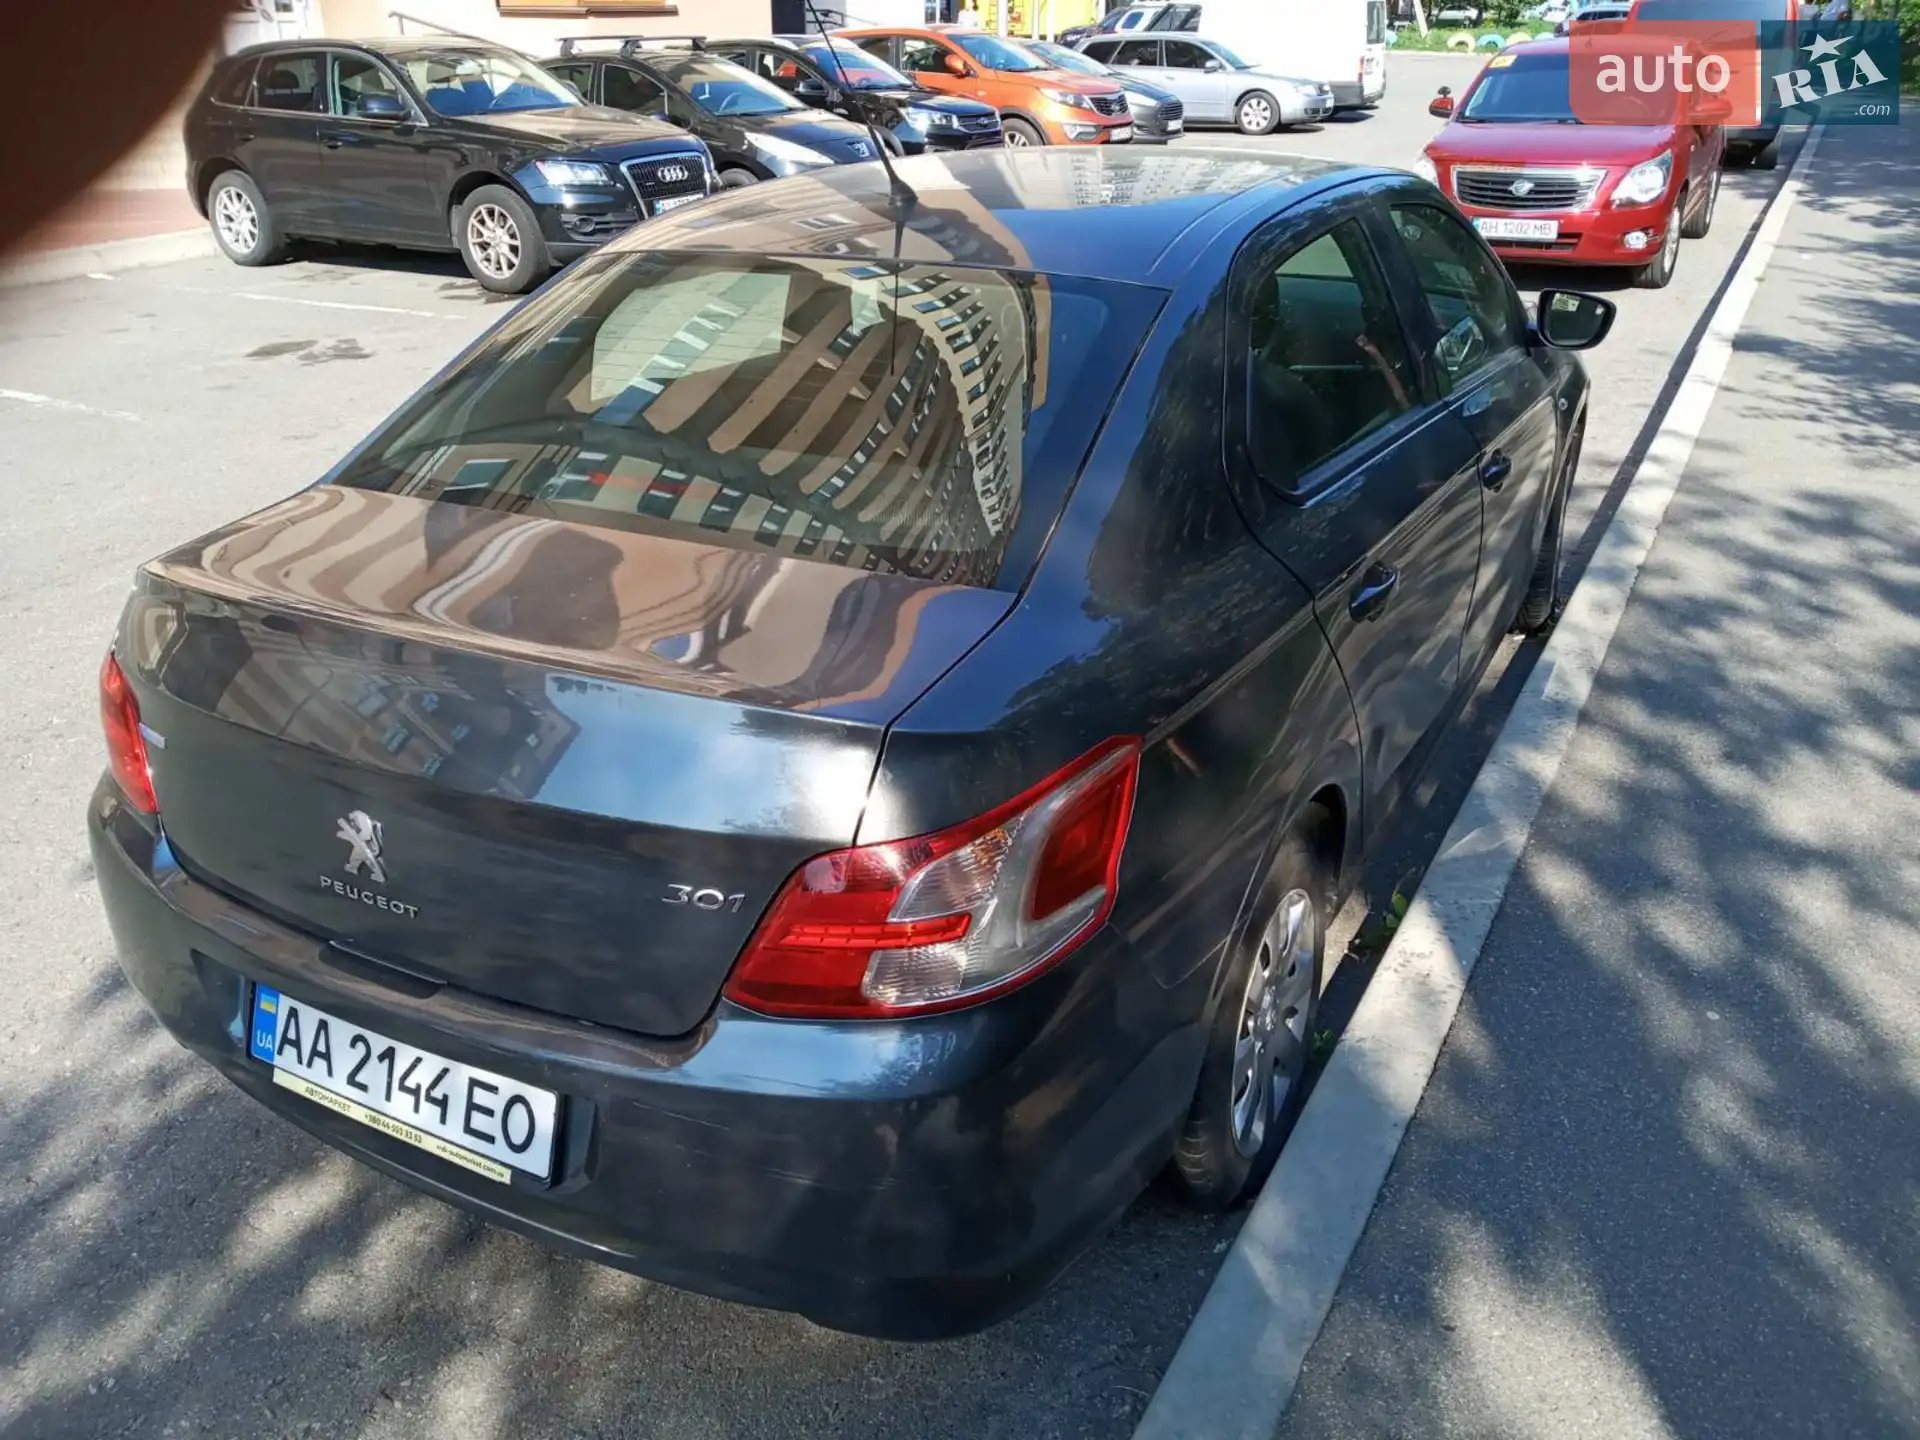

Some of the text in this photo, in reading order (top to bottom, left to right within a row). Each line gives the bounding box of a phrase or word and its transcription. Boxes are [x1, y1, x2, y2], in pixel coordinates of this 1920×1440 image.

[1481, 220, 1553, 236] AH 1202 MB
[319, 875, 419, 919] PEUGEOT
[661, 883, 746, 913] 301
[256, 1030, 274, 1052] UA
[276, 1006, 536, 1154] AA 2144 EO
